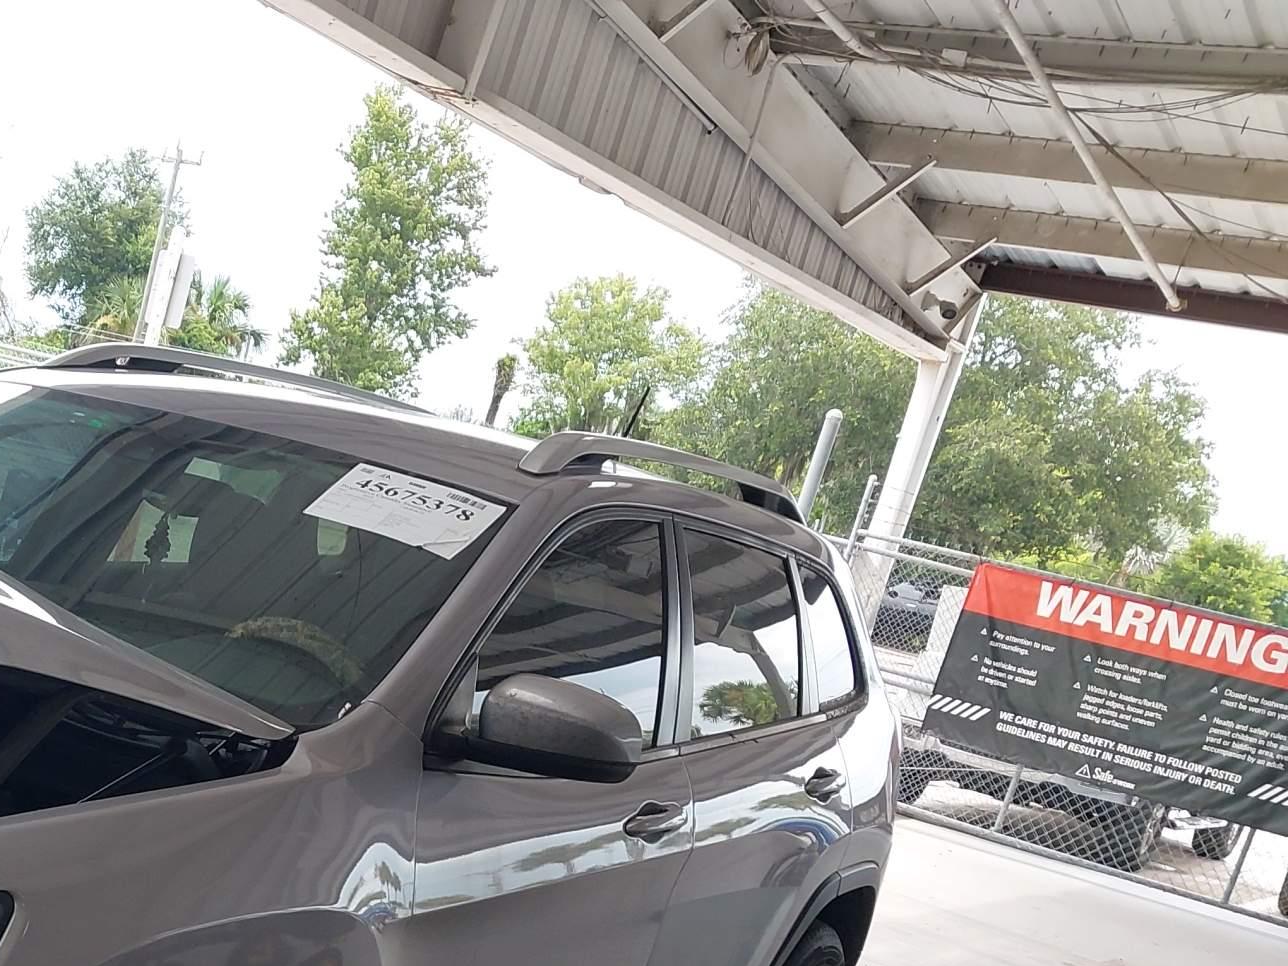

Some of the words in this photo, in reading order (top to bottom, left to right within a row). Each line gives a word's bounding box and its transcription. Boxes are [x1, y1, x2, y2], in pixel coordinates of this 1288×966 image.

[355, 479, 475, 521] 45675378
[1036, 580, 1288, 674] WARNING
[992, 630, 1004, 640] Pay
[1005, 635, 1033, 646] attention
[1033, 641, 1040, 649] to
[1041, 644, 1056, 653] your
[980, 665, 988, 673] be
[988, 668, 1007, 678] driven
[983, 657, 993, 665] No
[1016, 667, 1038, 677] should
[1094, 667, 1122, 680] crossing
[1097, 657, 1113, 667] Look
[1113, 661, 1129, 671] both
[1129, 666, 1147, 676] ways
[1148, 670, 1167, 680] when
[1087, 684, 1108, 695] Watch
[1108, 690, 1118, 698] for
[1224, 688, 1248, 700] Closed
[1248, 695, 1259, 703] toe
[1082, 693, 1106, 704] jagged
[1126, 704, 1144, 714] loose
[1220, 699, 1238, 708] must
[1238, 702, 1248, 710] be
[1249, 706, 1266, 714] worn
[1080, 702, 1098, 713] sharp
[1098, 708, 1118, 718] points
[1118, 713, 1132, 721] and
[1132, 717, 1156, 727] uneven
[1209, 727, 1231, 737] permit
[1231, 733, 1257, 743] children
[1213, 716, 1235, 728] Health
[1249, 727, 1270, 737] safety
[999, 710, 1015, 722] WE
[1015, 715, 1038, 729] CARE
[1038, 721, 1056, 734] FOR
[1057, 727, 1080, 740] YOUR
[1080, 733, 1115, 750] SAFETY.
[1116, 743, 1153, 760] FAILURE
[1154, 752, 1166, 763] TO
[1166, 757, 1205, 774] FOLLOW
[1205, 767, 1242, 784] POSTED
[1206, 736, 1222, 744] yard
[996, 722, 1047, 744] GUIDELINES
[1047, 736, 1068, 749] MAY
[1067, 742, 1102, 758] RESULT
[1101, 751, 1113, 762] IN
[1114, 755, 1153, 772] SERIOUS
[1153, 766, 1188, 782] INJURY
[1188, 775, 1202, 786] OR
[1203, 780, 1235, 795] DEATH.
[1247, 755, 1256, 764] by
